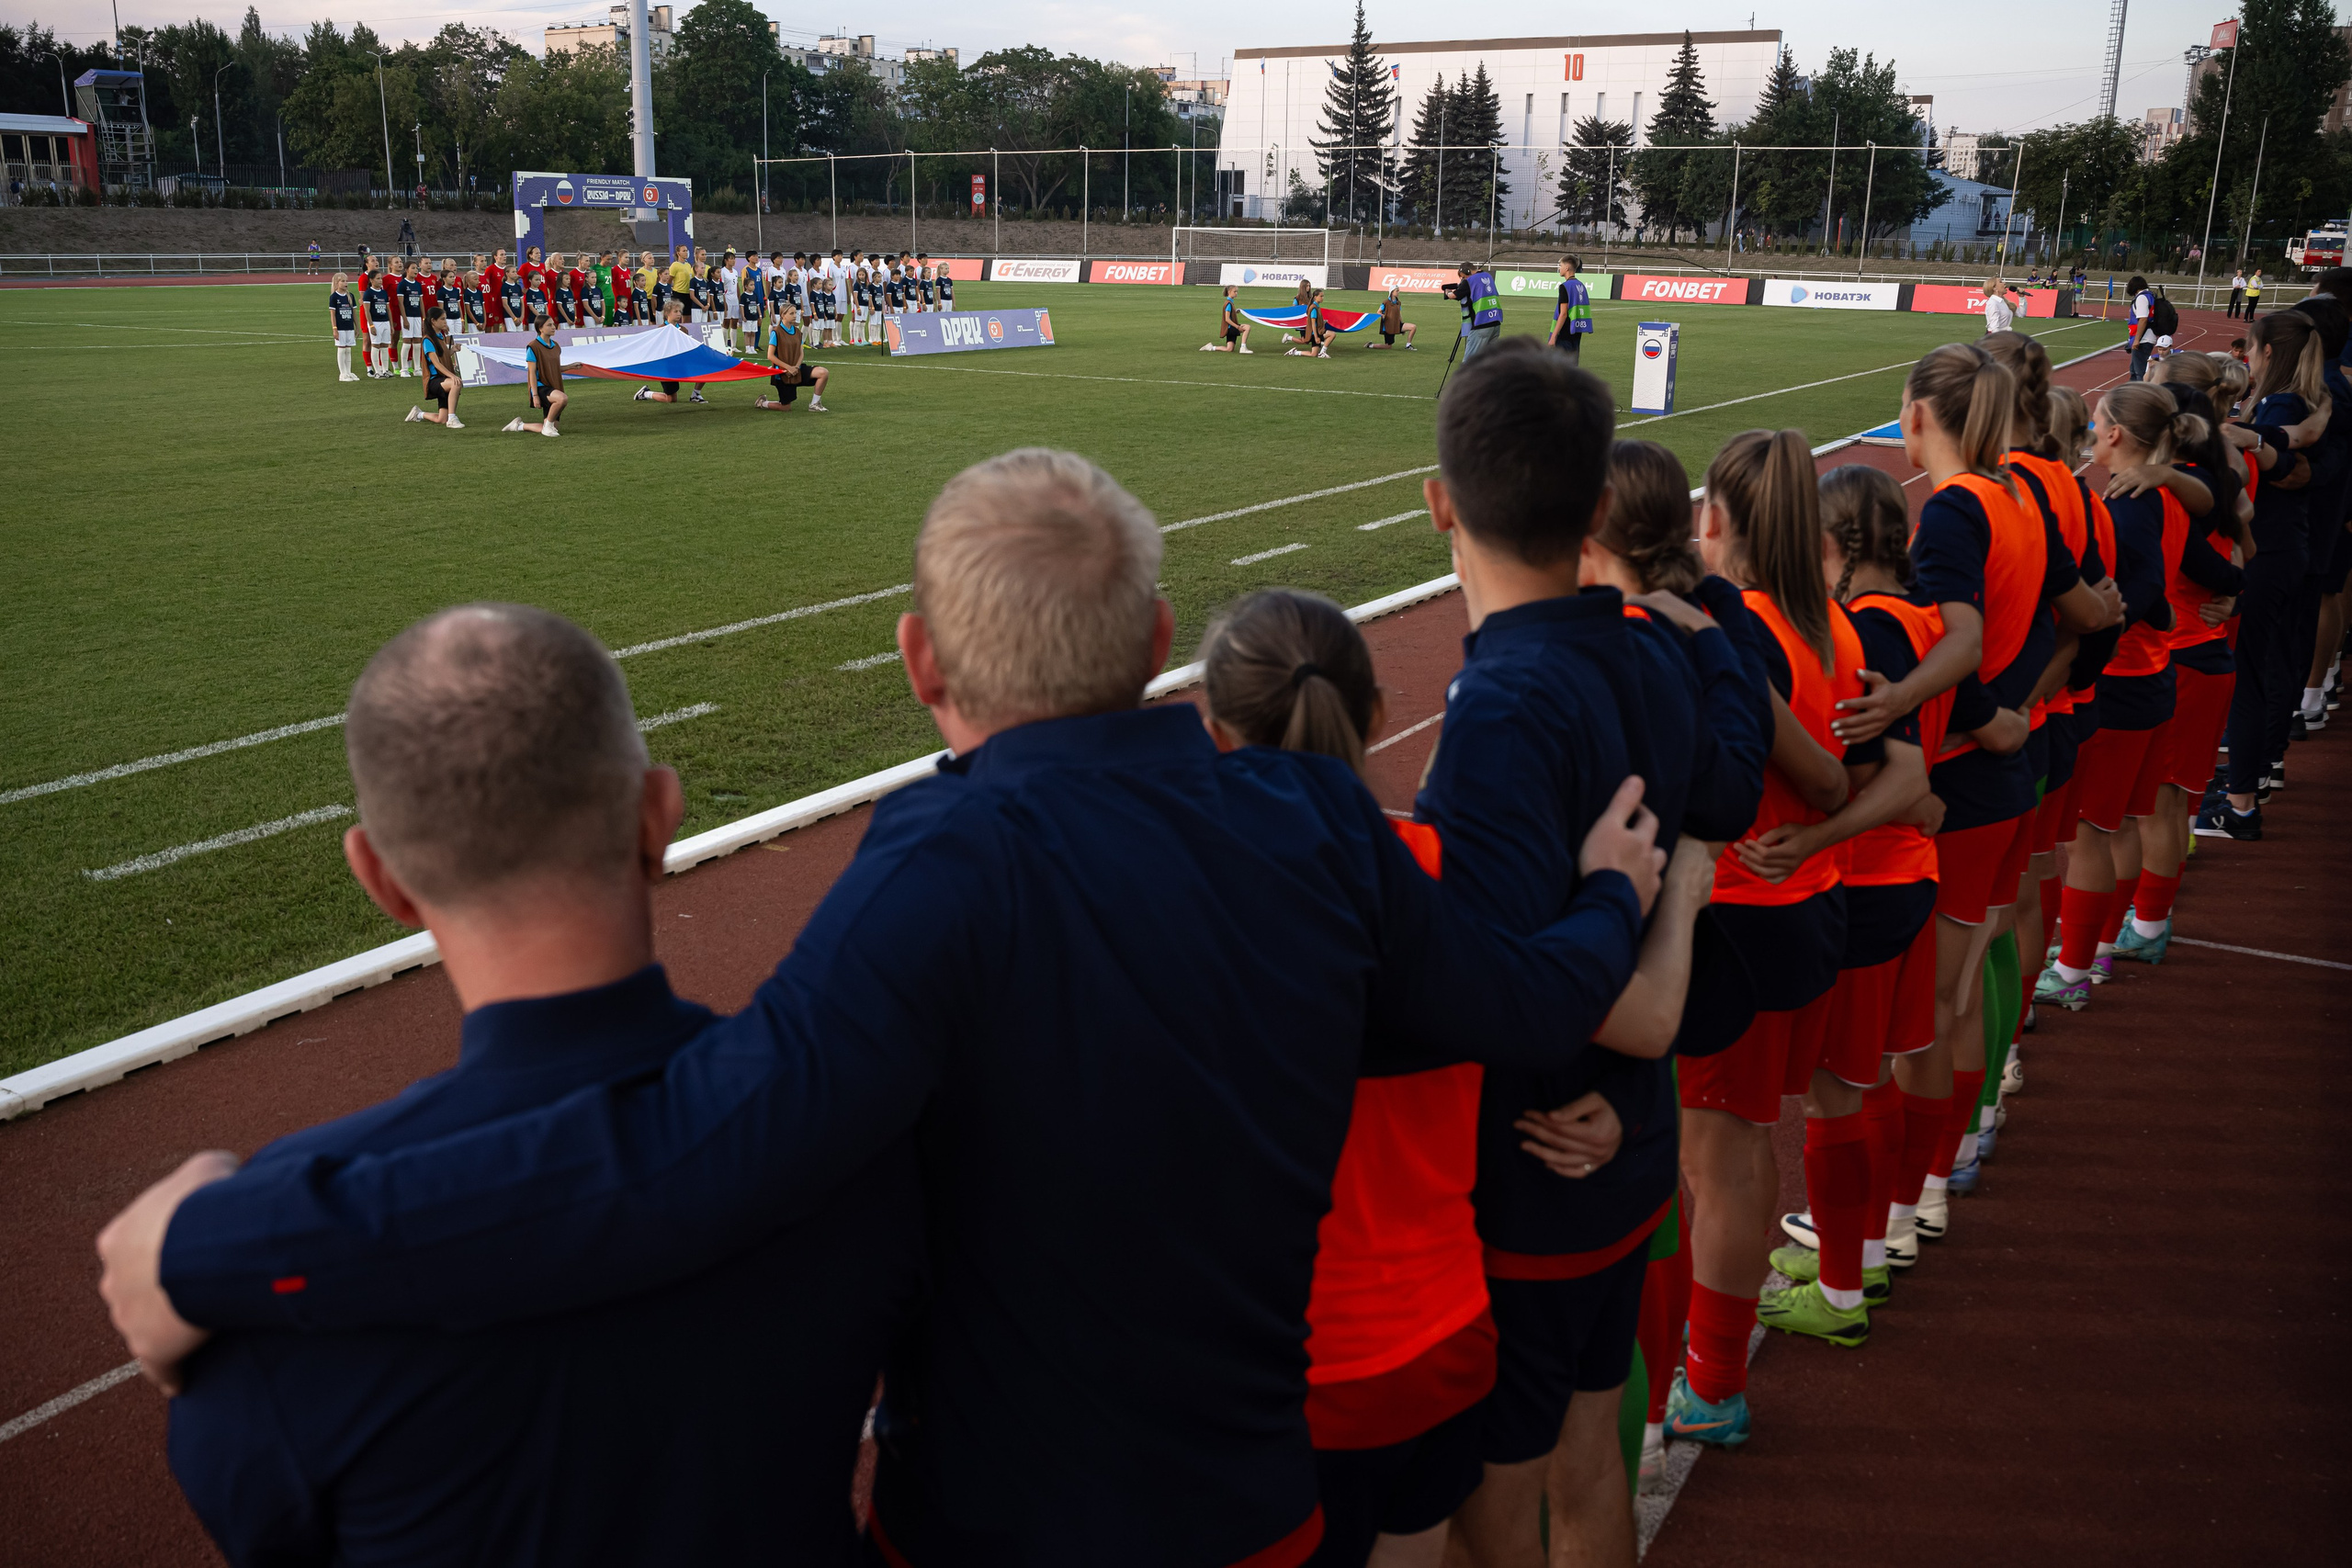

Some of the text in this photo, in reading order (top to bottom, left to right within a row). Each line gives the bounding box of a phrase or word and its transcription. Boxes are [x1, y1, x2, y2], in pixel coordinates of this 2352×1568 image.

[1565, 54, 1584, 81] 10
[587, 190, 609, 200] RUSSIA
[616, 191, 631, 201] DPRK
[1104, 265, 1169, 281] FONBET
[1261, 273, 1306, 281] НОВАТЭК
[605, 276, 612, 284] 21
[625, 279, 631, 288] 10
[426, 285, 435, 295] 13
[481, 284, 491, 294] 20
[1641, 280, 1727, 299] FONBET
[1815, 292, 1871, 301] НОВАТЭК
[939, 317, 984, 346] DPRK
